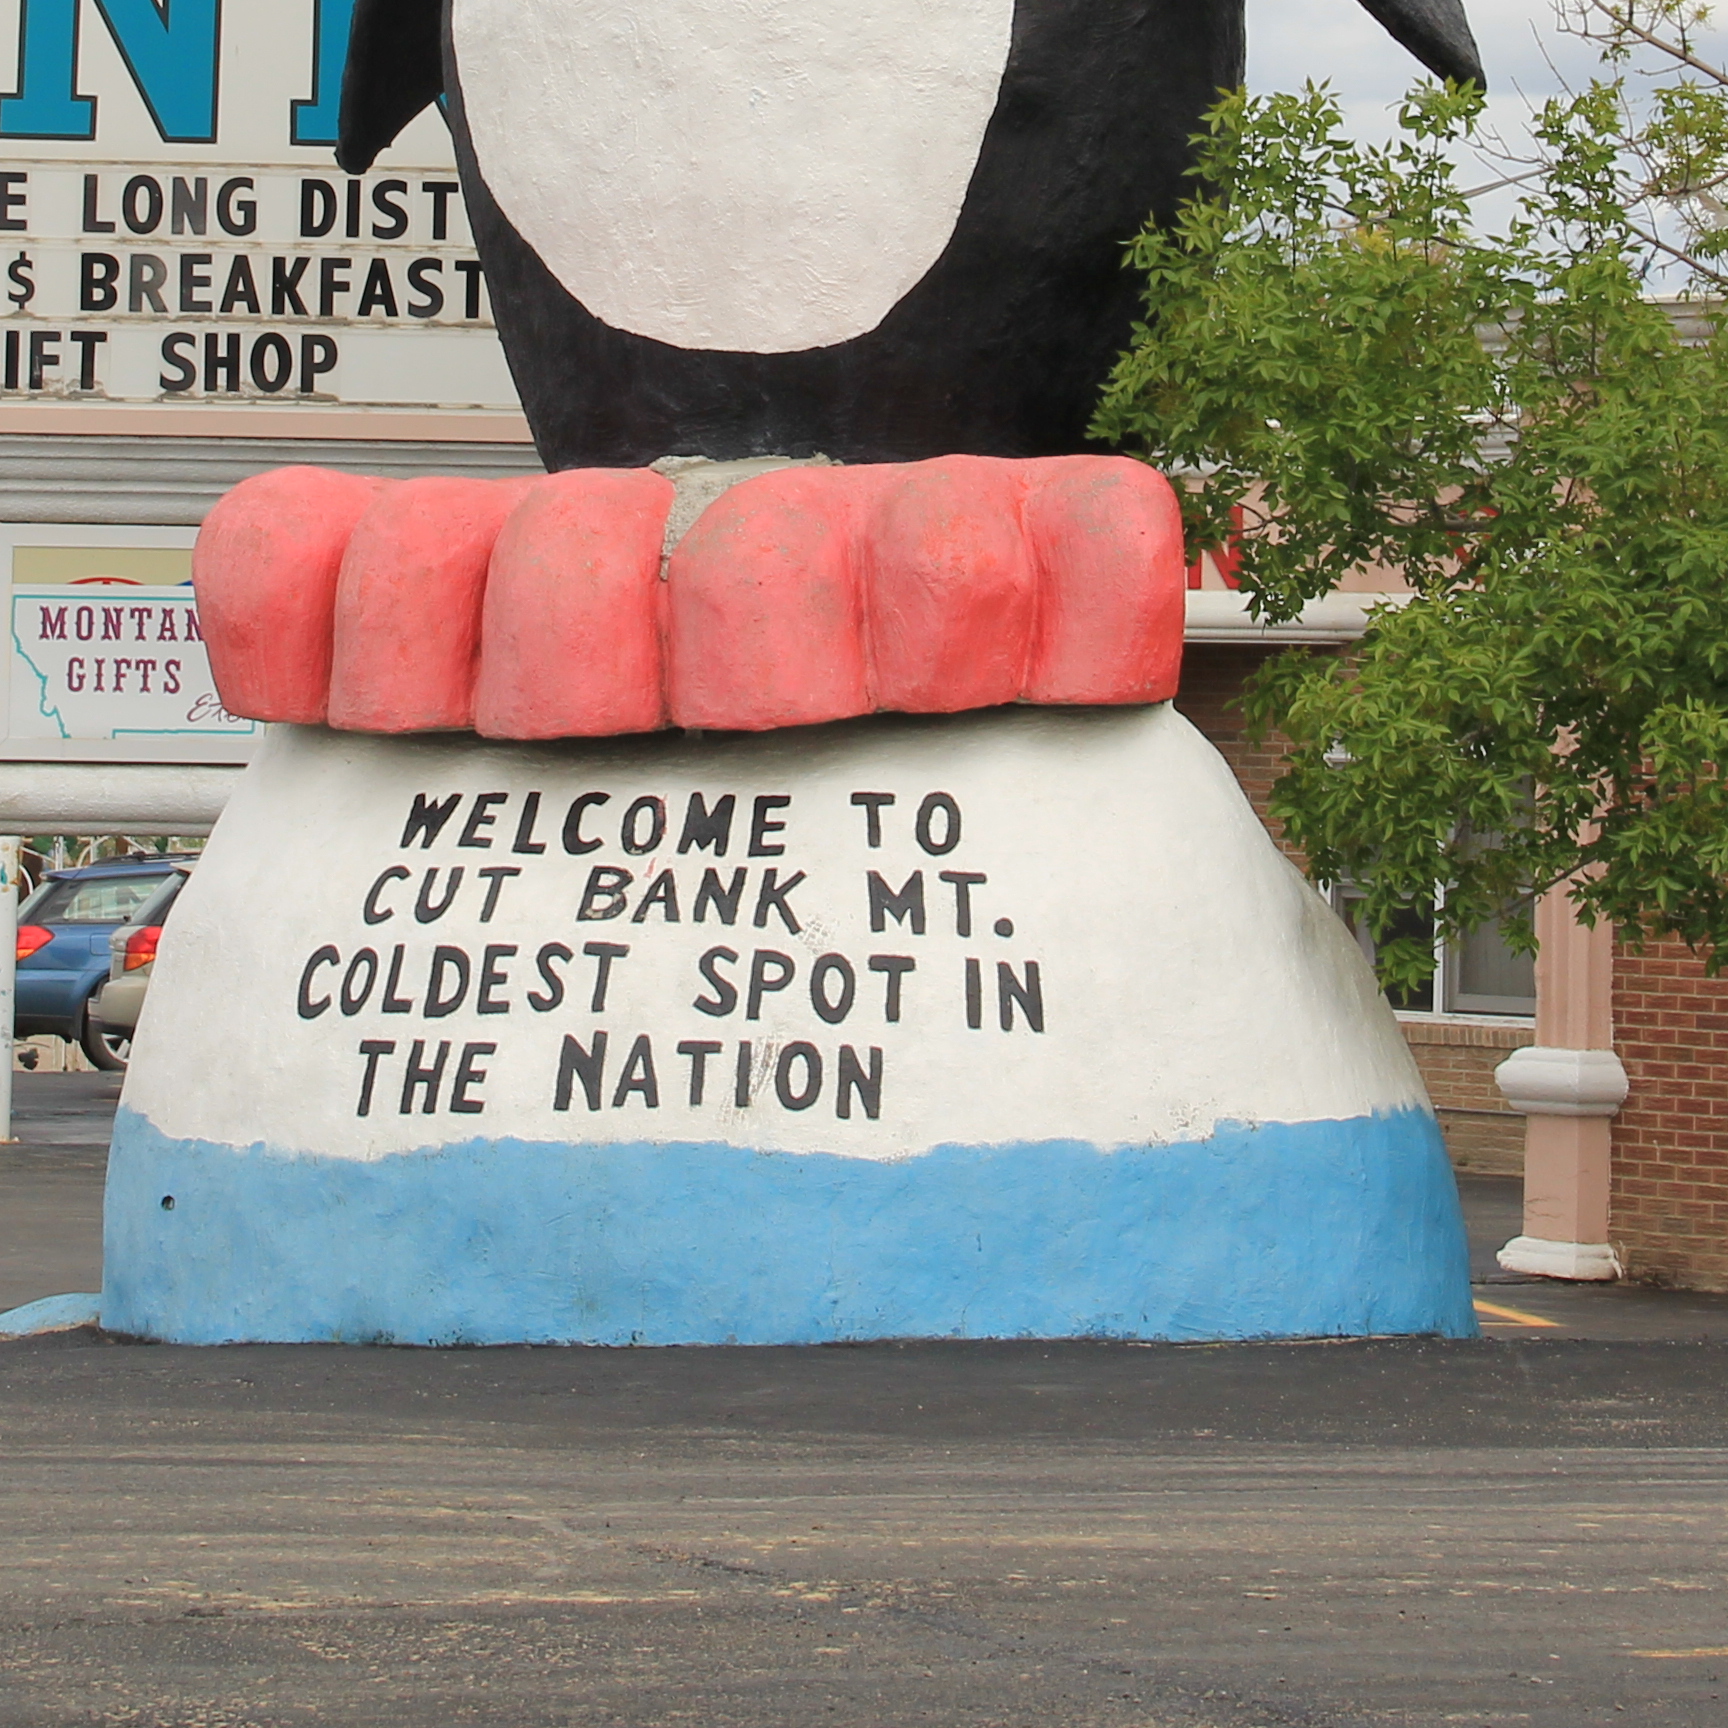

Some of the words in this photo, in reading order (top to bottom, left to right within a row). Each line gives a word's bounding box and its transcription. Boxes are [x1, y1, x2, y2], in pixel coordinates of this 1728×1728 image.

[81, 173, 258, 237] LONG
[299, 178, 460, 241] DIST
[7, 250, 35, 311] $
[79, 252, 484, 319] BREAKFAST
[159, 331, 338, 393] SHOP
[66, 656, 181, 695] GIFTS
[401, 791, 791, 857] WELCOME
[850, 792, 962, 856] TO
[363, 865, 521, 925] CUT
[577, 866, 807, 935] BANK
[868, 870, 1014, 938] MT.
[297, 942, 629, 1020] COLDEST
[693, 946, 915, 1025] SPOT
[966, 958, 1045, 1033] IN
[357, 1040, 497, 1117] THE
[553, 1031, 883, 1120] NATION
